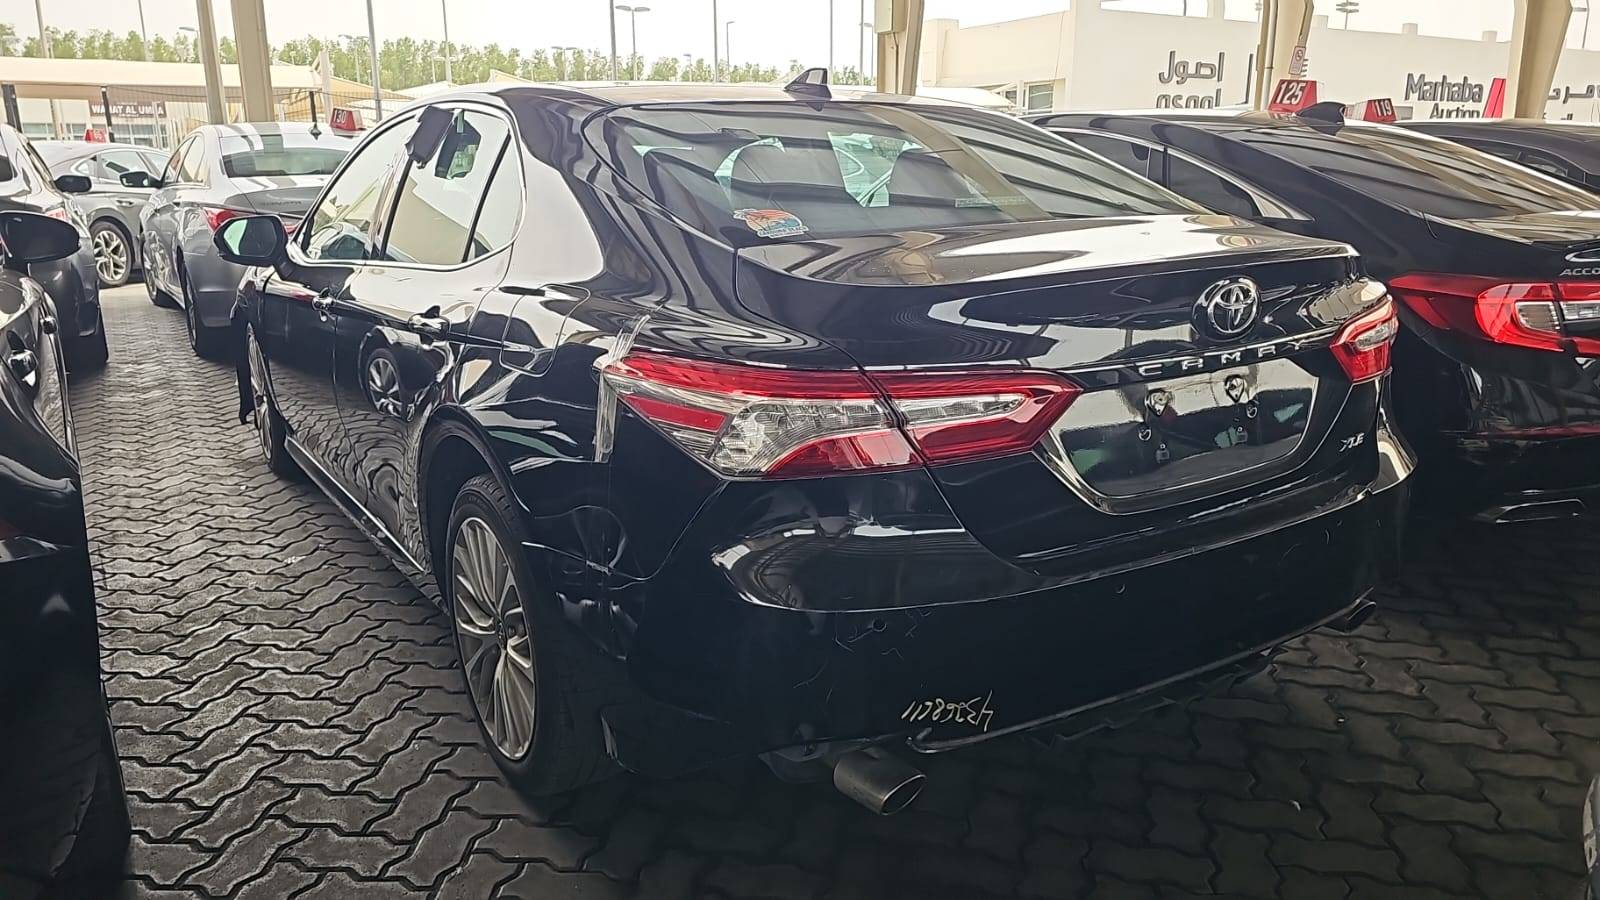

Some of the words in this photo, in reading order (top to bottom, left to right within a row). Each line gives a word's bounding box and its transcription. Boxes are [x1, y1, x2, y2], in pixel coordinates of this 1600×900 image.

[1158, 50, 1225, 84] اصول
[1276, 81, 1306, 105] 125
[1404, 73, 1484, 103] Marhaba
[91, 104, 124, 114] WAAT
[125, 105, 137, 114] AL
[138, 105, 164, 115] UMA
[333, 109, 347, 124] 130
[1375, 100, 1392, 117] 119
[1138, 339, 1306, 376] CAMRY
[1339, 432, 1365, 452] XLE
